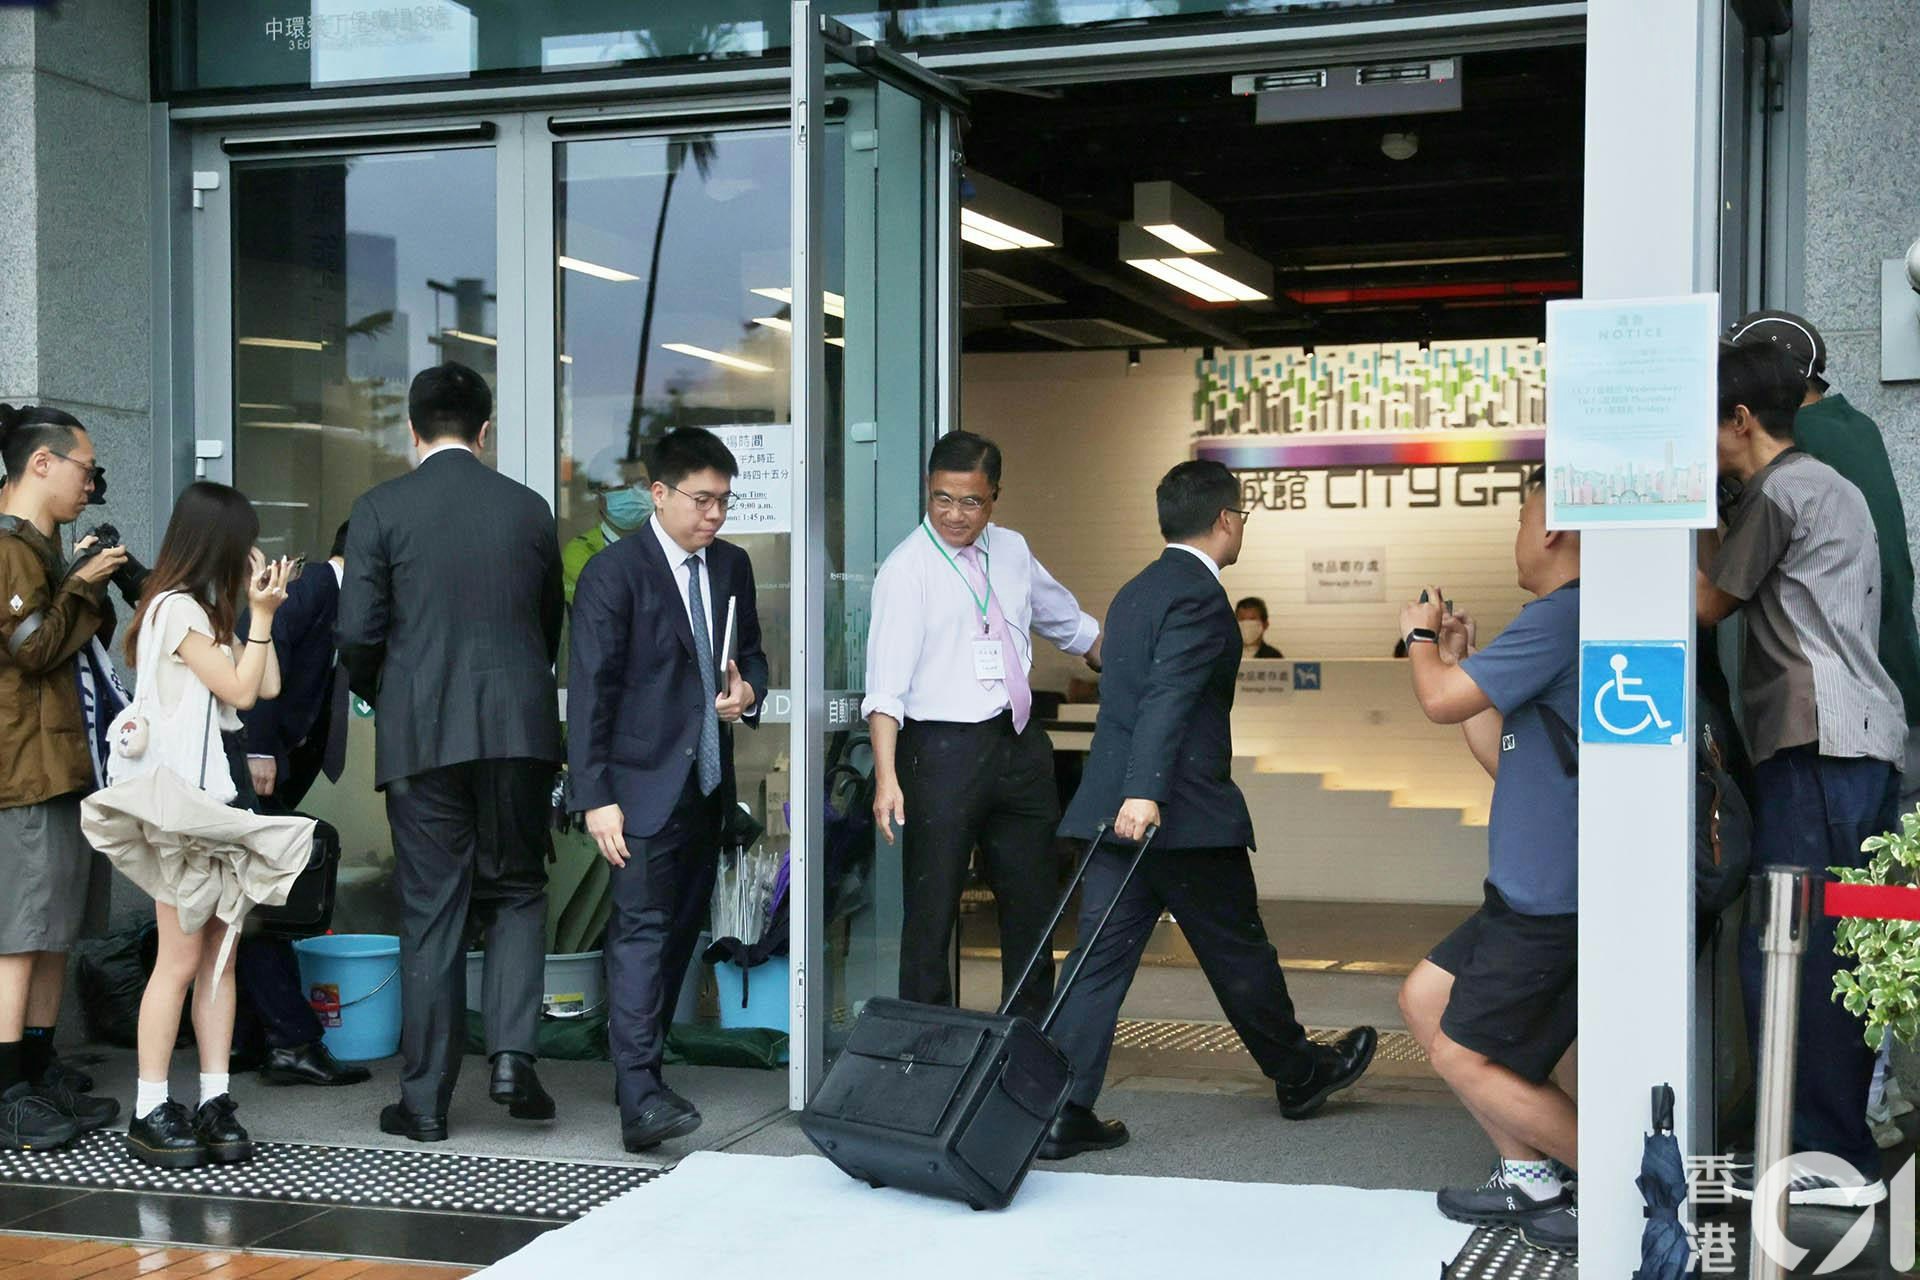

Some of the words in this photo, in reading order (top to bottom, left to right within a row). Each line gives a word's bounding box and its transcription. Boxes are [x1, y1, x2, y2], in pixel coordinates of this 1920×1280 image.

[1599, 328, 1663, 340] NOTICE
[1326, 466, 1441, 508] CITY
[750, 490, 768, 498] Time
[740, 502, 756, 510] 9:00
[743, 512, 759, 521] 1:45
